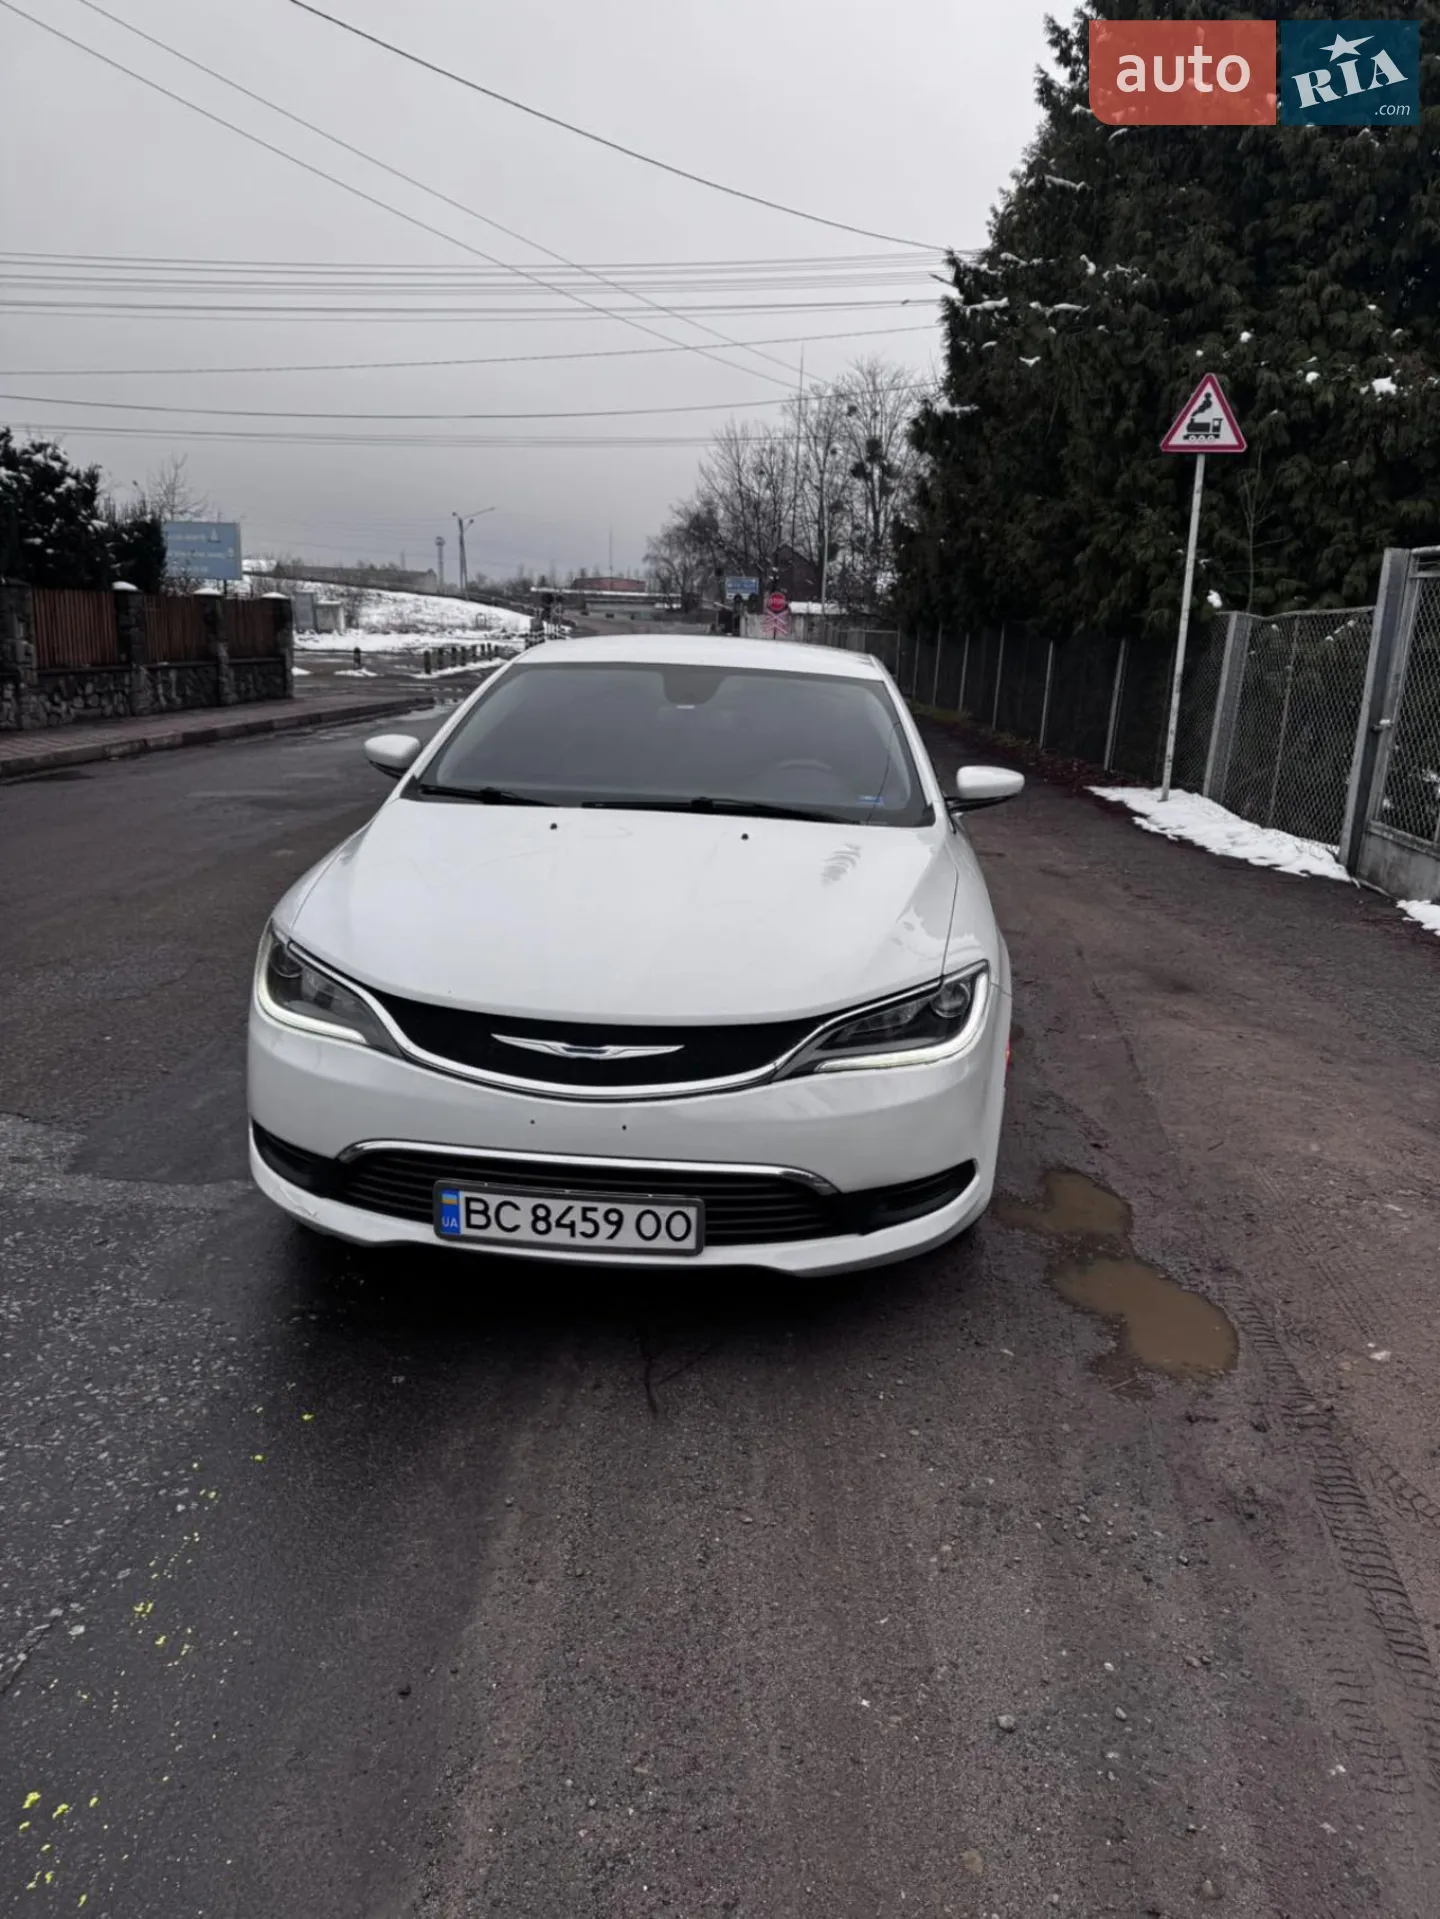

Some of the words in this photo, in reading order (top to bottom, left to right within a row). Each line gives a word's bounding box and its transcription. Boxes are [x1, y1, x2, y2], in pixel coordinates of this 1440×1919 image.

[441, 1216, 458, 1228] UA
[464, 1196, 522, 1233] BC
[530, 1202, 624, 1240] 8459
